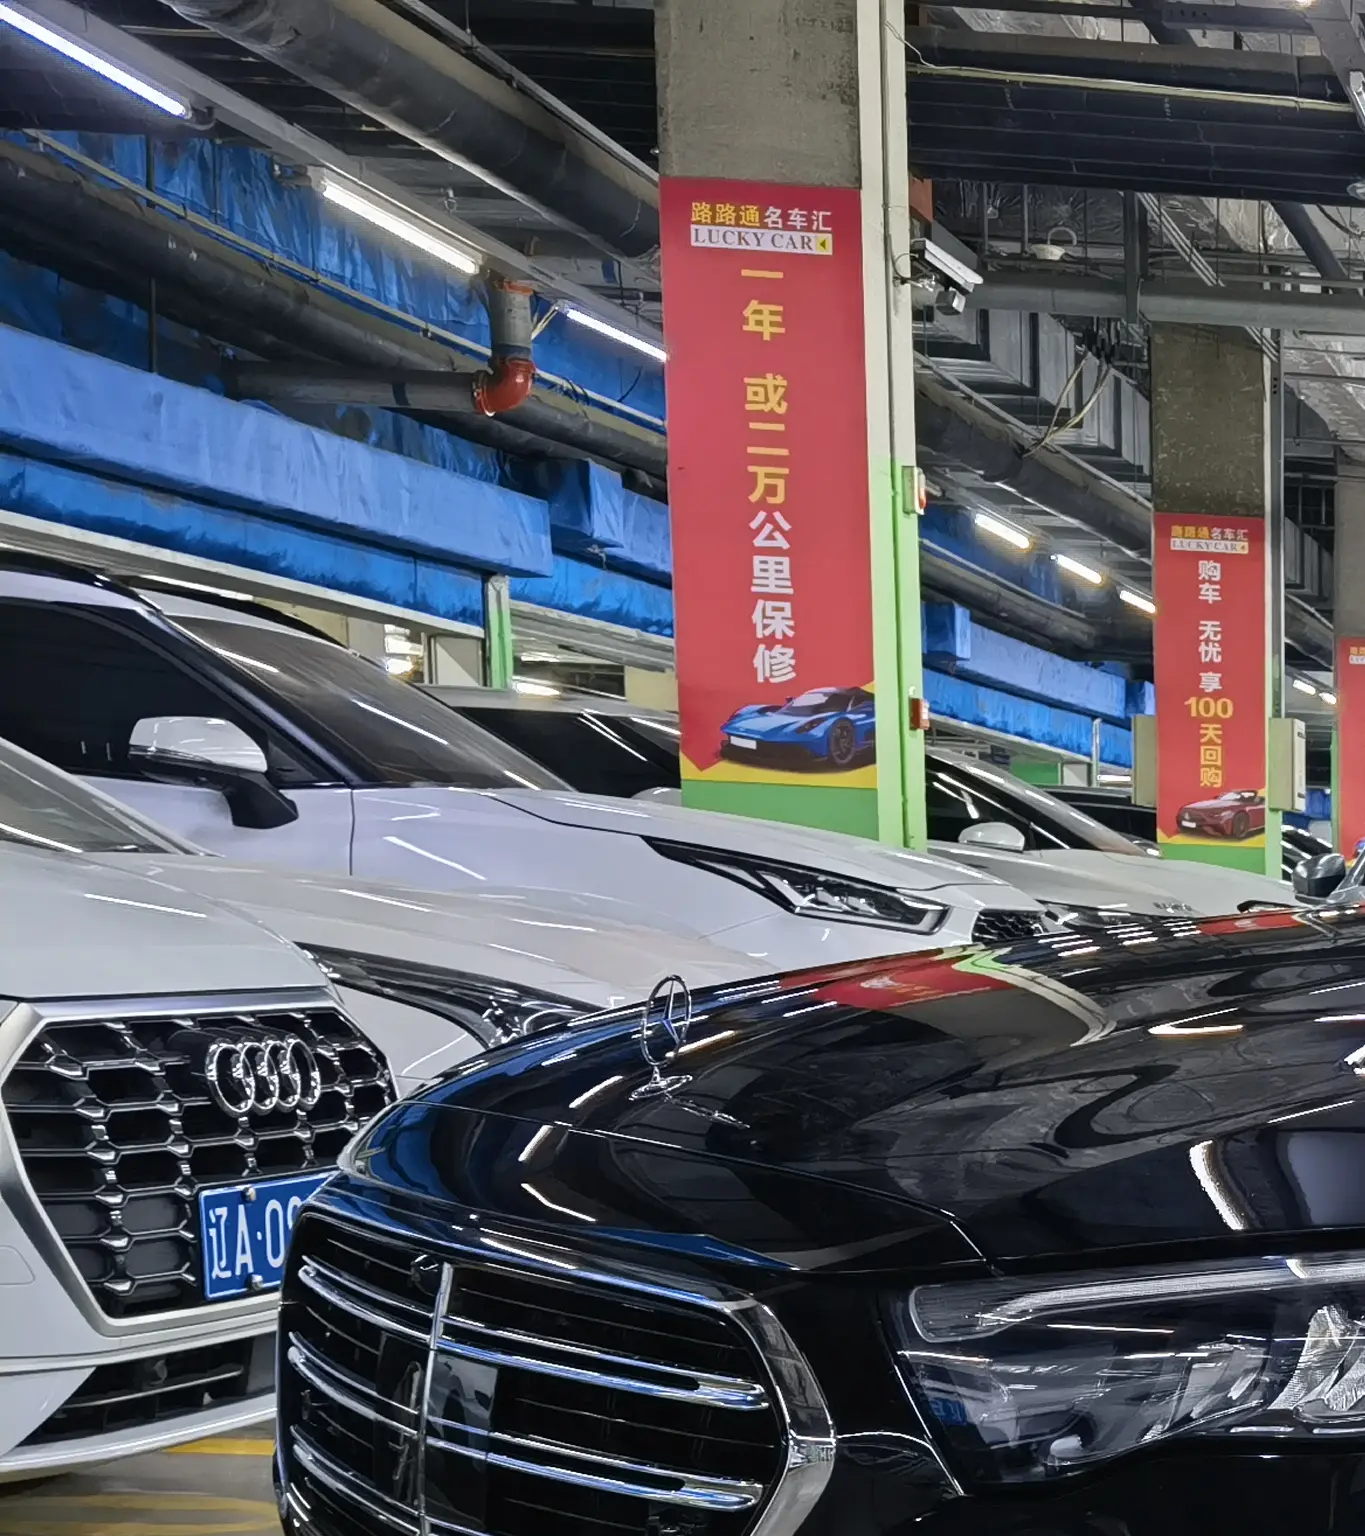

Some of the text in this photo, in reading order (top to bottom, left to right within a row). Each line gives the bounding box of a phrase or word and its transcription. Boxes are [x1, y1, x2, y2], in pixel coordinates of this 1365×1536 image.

[690, 201, 832, 231] 路路通名车汇
[694, 228, 813, 250] LUCKY CAR
